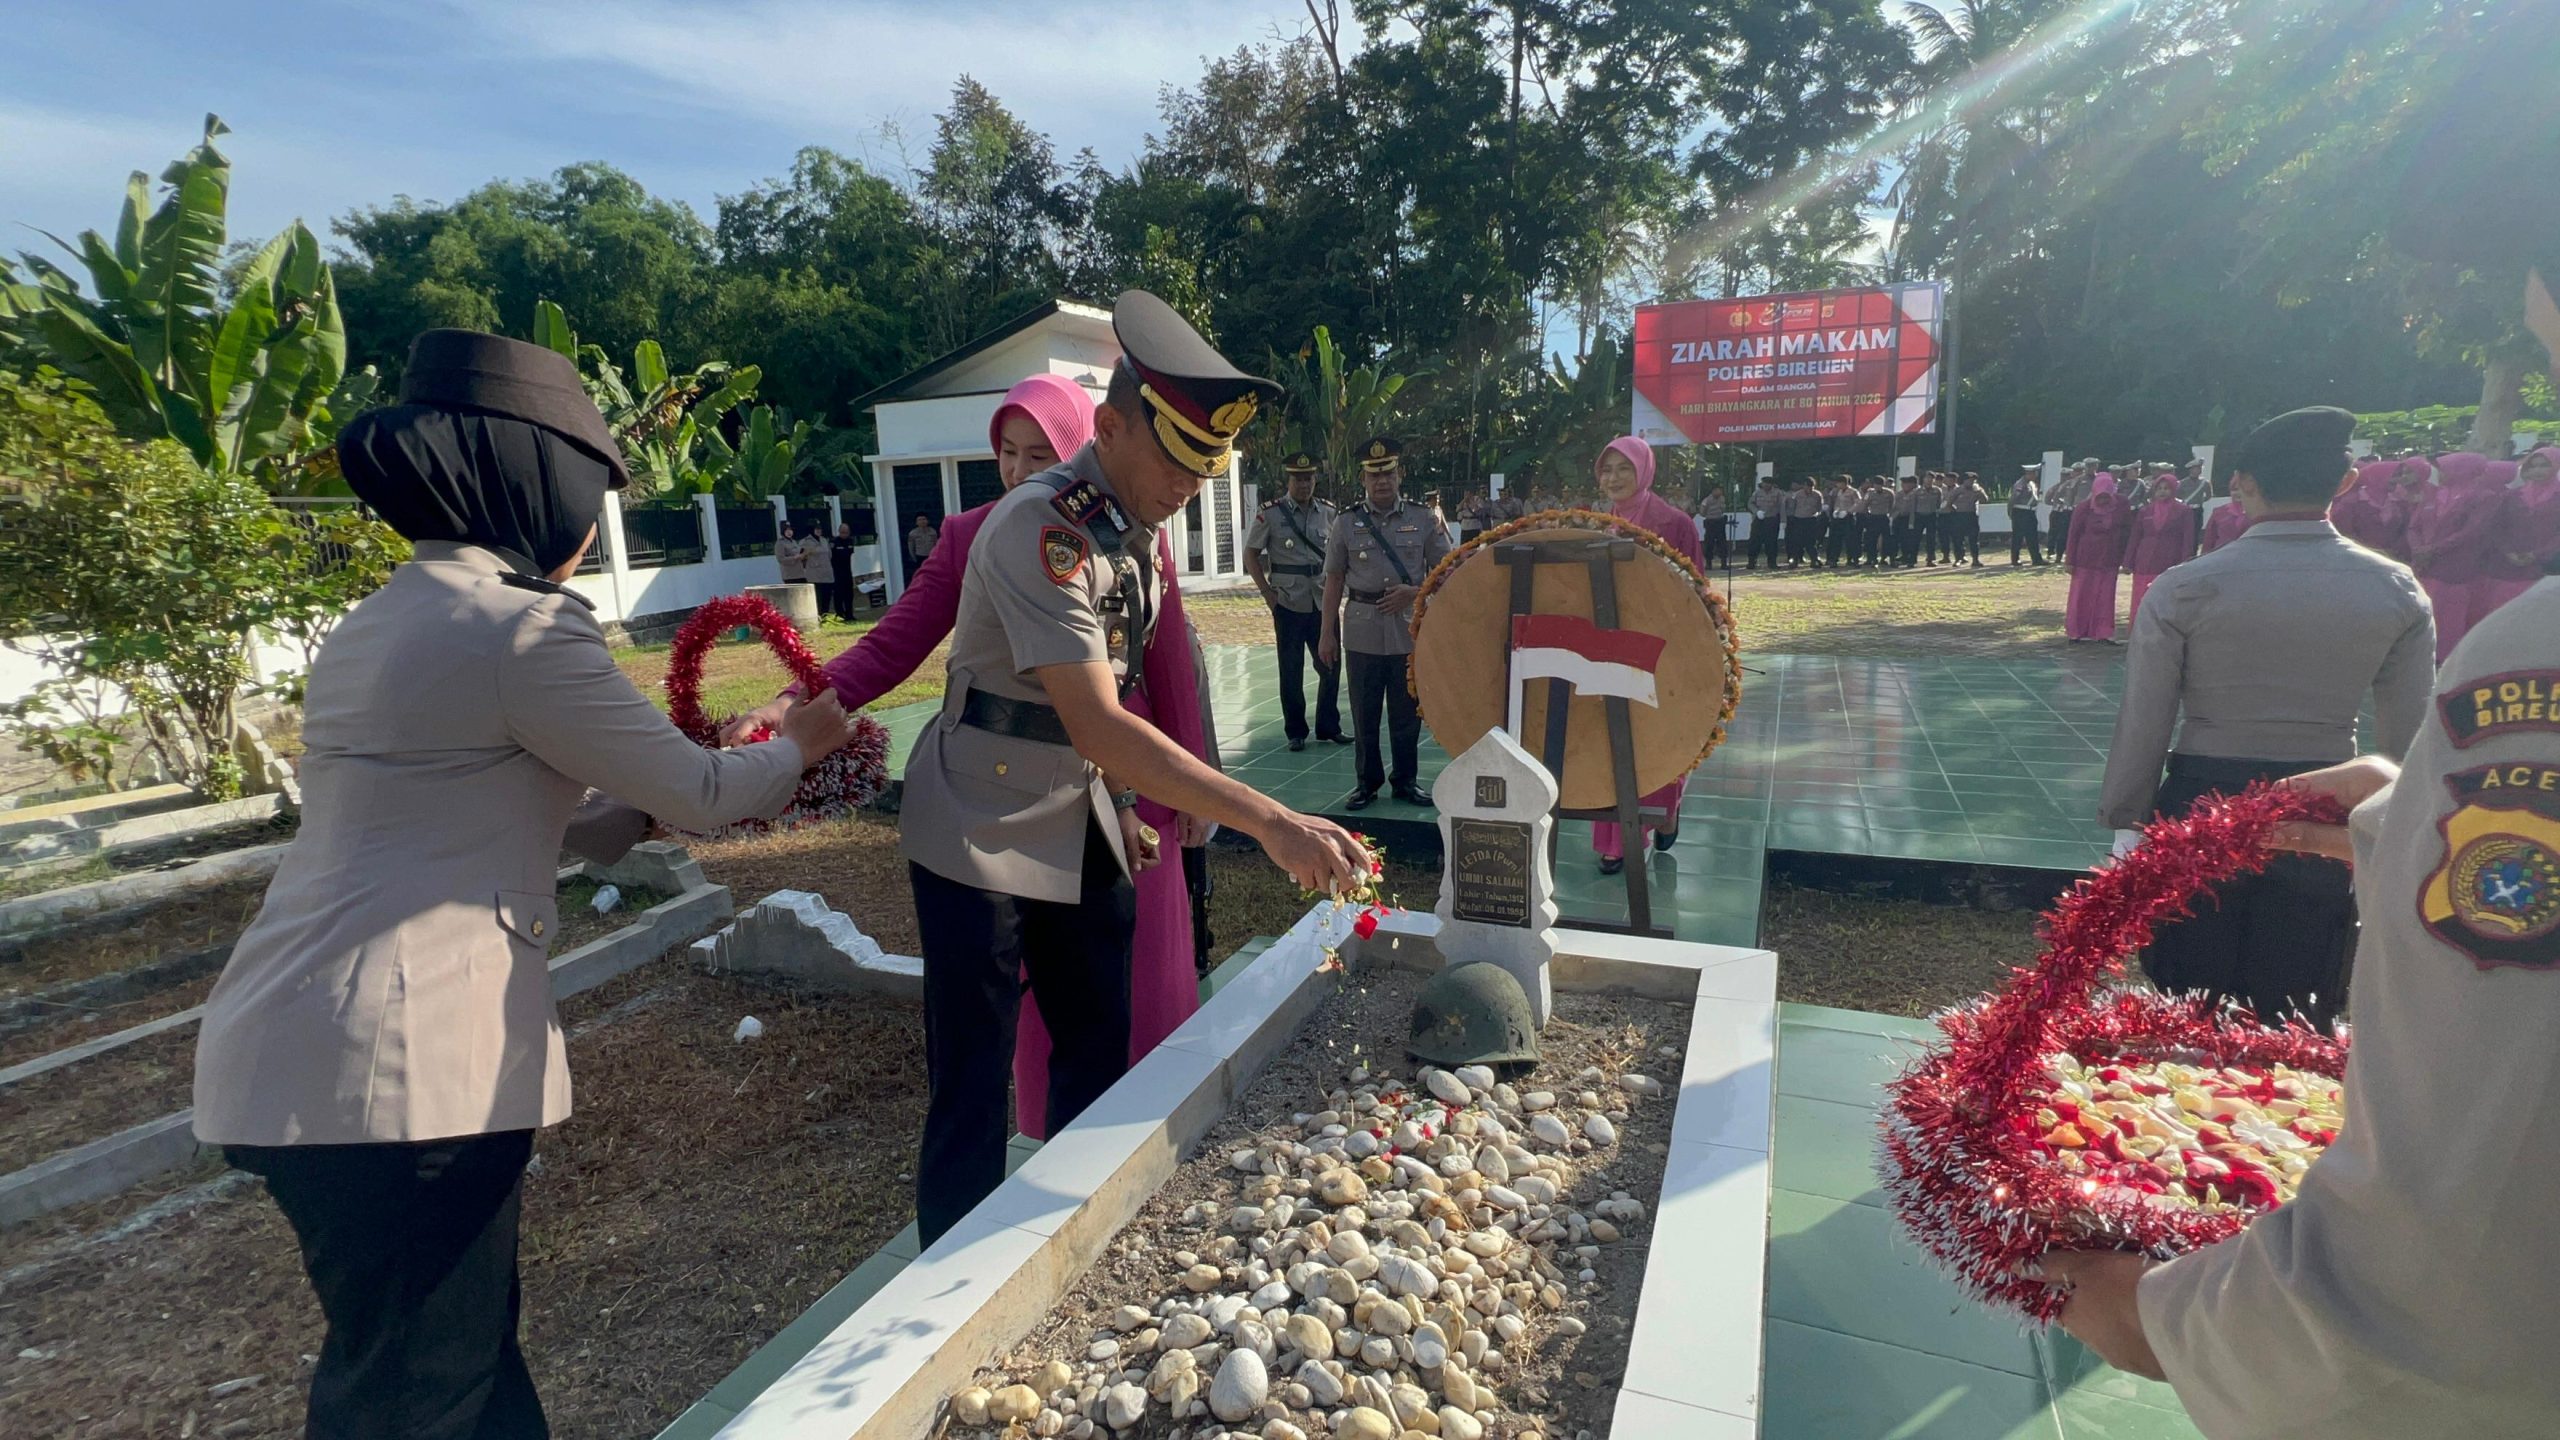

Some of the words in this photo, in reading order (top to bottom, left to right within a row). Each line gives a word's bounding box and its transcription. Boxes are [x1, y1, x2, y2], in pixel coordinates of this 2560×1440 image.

[1671, 335, 1774, 364] ZIARAH
[1780, 327, 1898, 357] MAKAM
[1708, 363, 1774, 382] POLRES
[1777, 358, 1855, 378] BIREUEN
[1741, 384, 1774, 394] DALAM
[1776, 382, 1816, 392] RANGKA
[1680, 403, 1704, 415] HARI
[1707, 399, 1780, 414] BHAYANGKARA
[1784, 398, 1796, 409] KE
[1816, 394, 1850, 408] TAHUN
[1853, 392, 1881, 405] 2026
[1718, 425, 1744, 433] POLRI
[1746, 423, 1775, 432] UNTUK
[1777, 420, 1837, 430] MASYARAKAT
